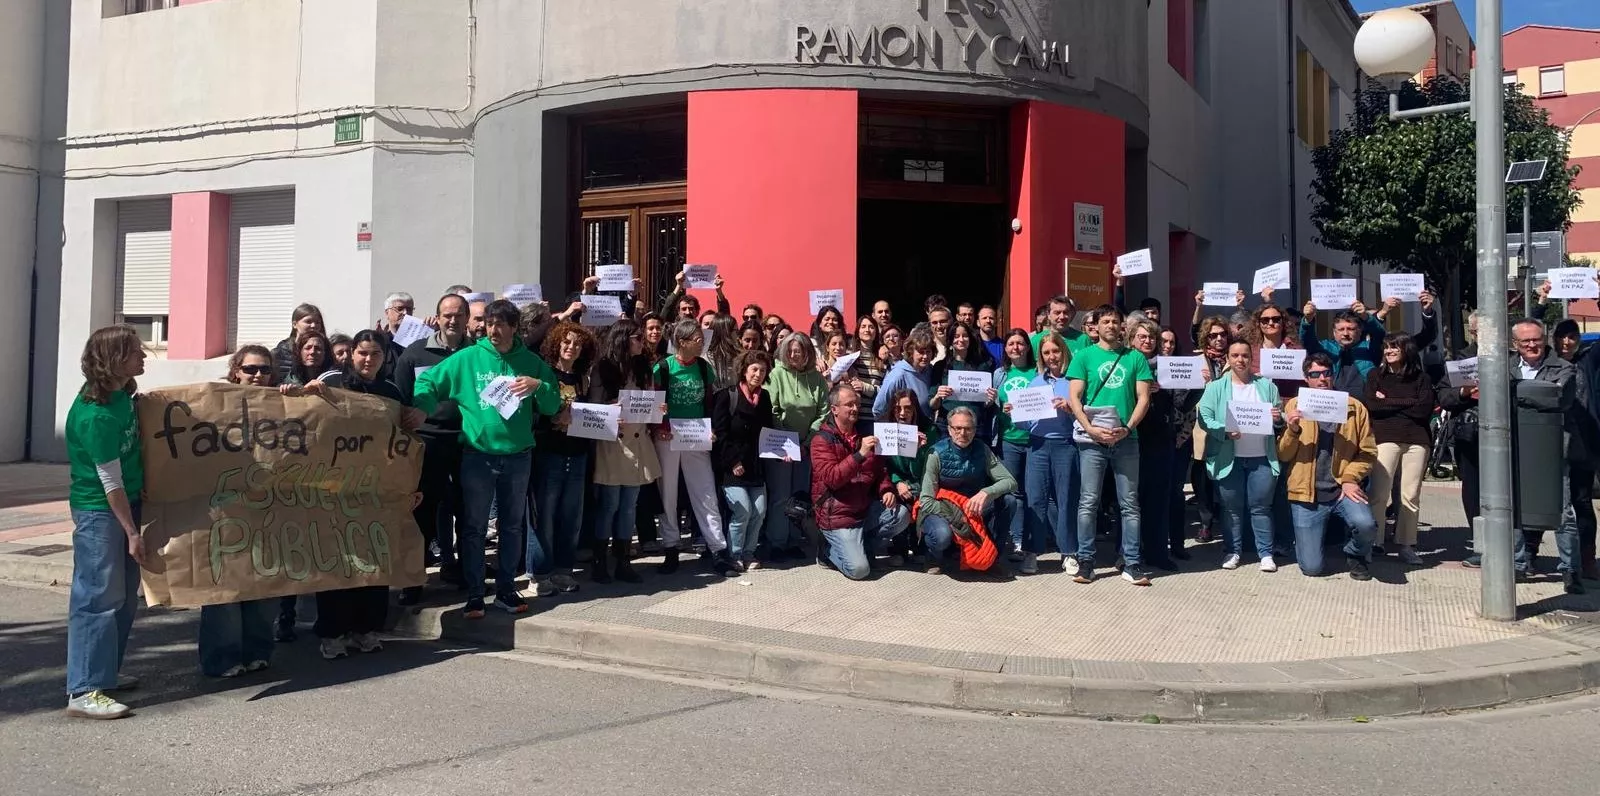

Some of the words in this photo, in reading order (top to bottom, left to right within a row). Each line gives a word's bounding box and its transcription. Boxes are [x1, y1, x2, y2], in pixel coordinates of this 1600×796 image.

[952, 25, 979, 62] Y
[990, 34, 1076, 77] CAJAL
[582, 408, 609, 417] Dejadnos
[583, 415, 606, 423] trabajar
[1237, 413, 1262, 421] trabajar
[331, 432, 373, 467] por
[387, 423, 411, 460] la
[209, 460, 381, 517] ESCUELA
